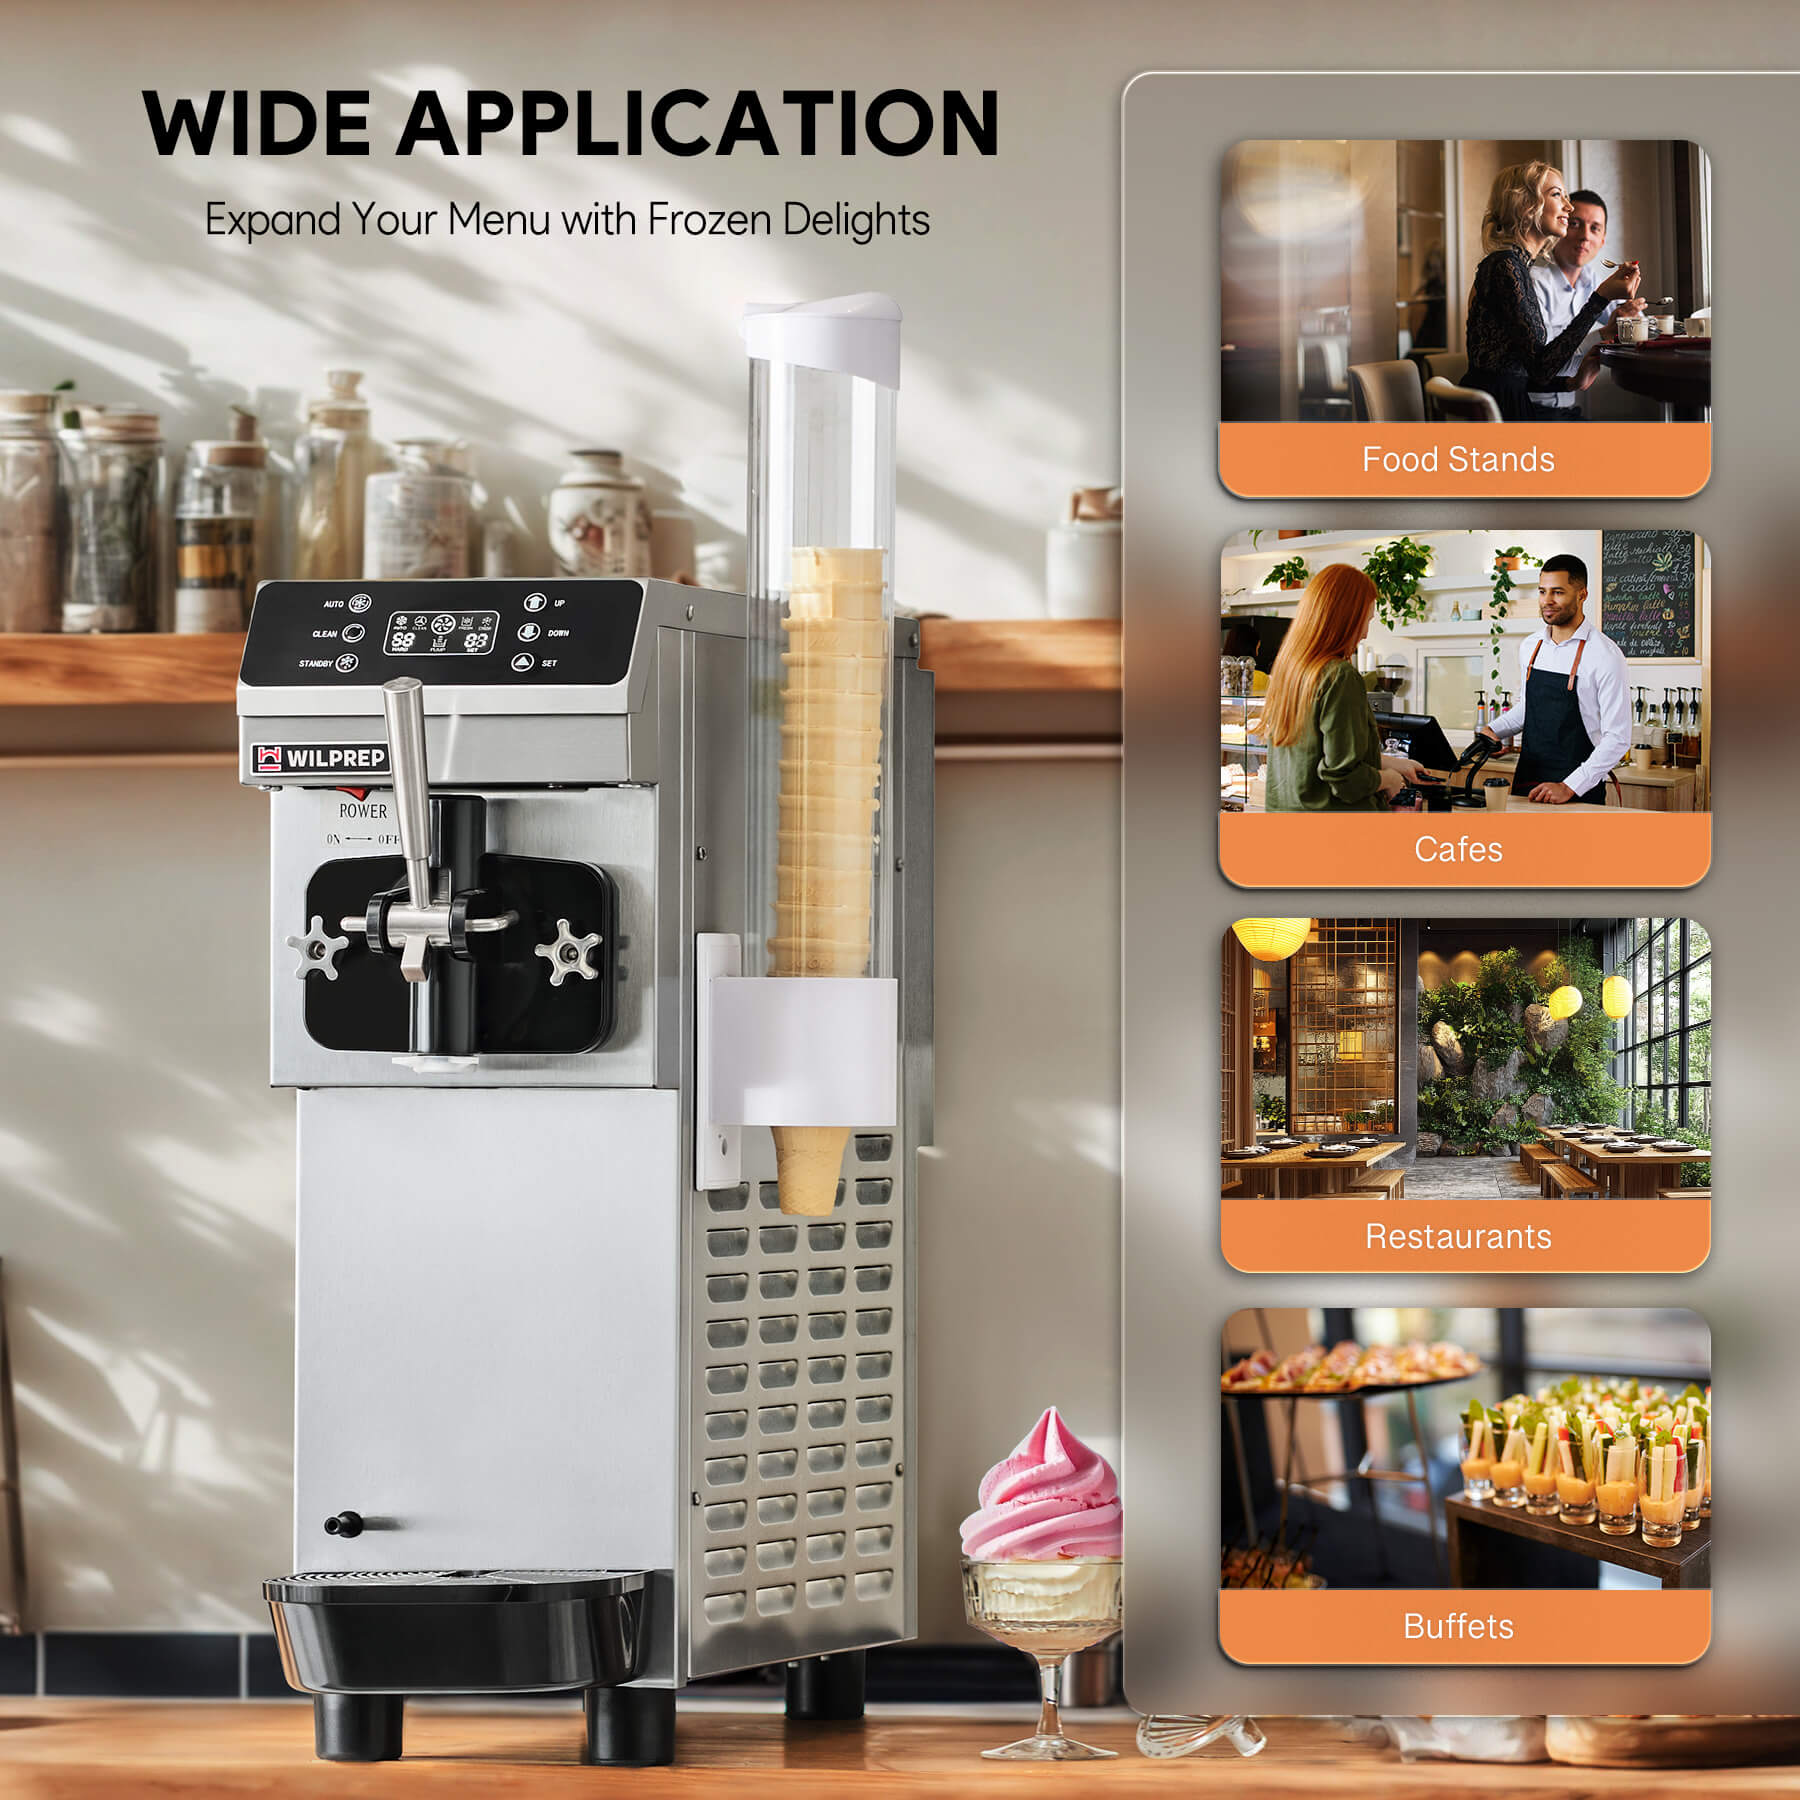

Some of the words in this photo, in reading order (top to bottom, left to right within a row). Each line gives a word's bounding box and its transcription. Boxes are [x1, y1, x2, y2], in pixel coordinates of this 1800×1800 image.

[323, 600, 344, 608] AUTO
[312, 630, 338, 638] CLEAN
[298, 660, 333, 668] STANDBY
[541, 660, 557, 668] SET
[286, 749, 385, 768] WILPREP
[327, 834, 340, 844] ON
